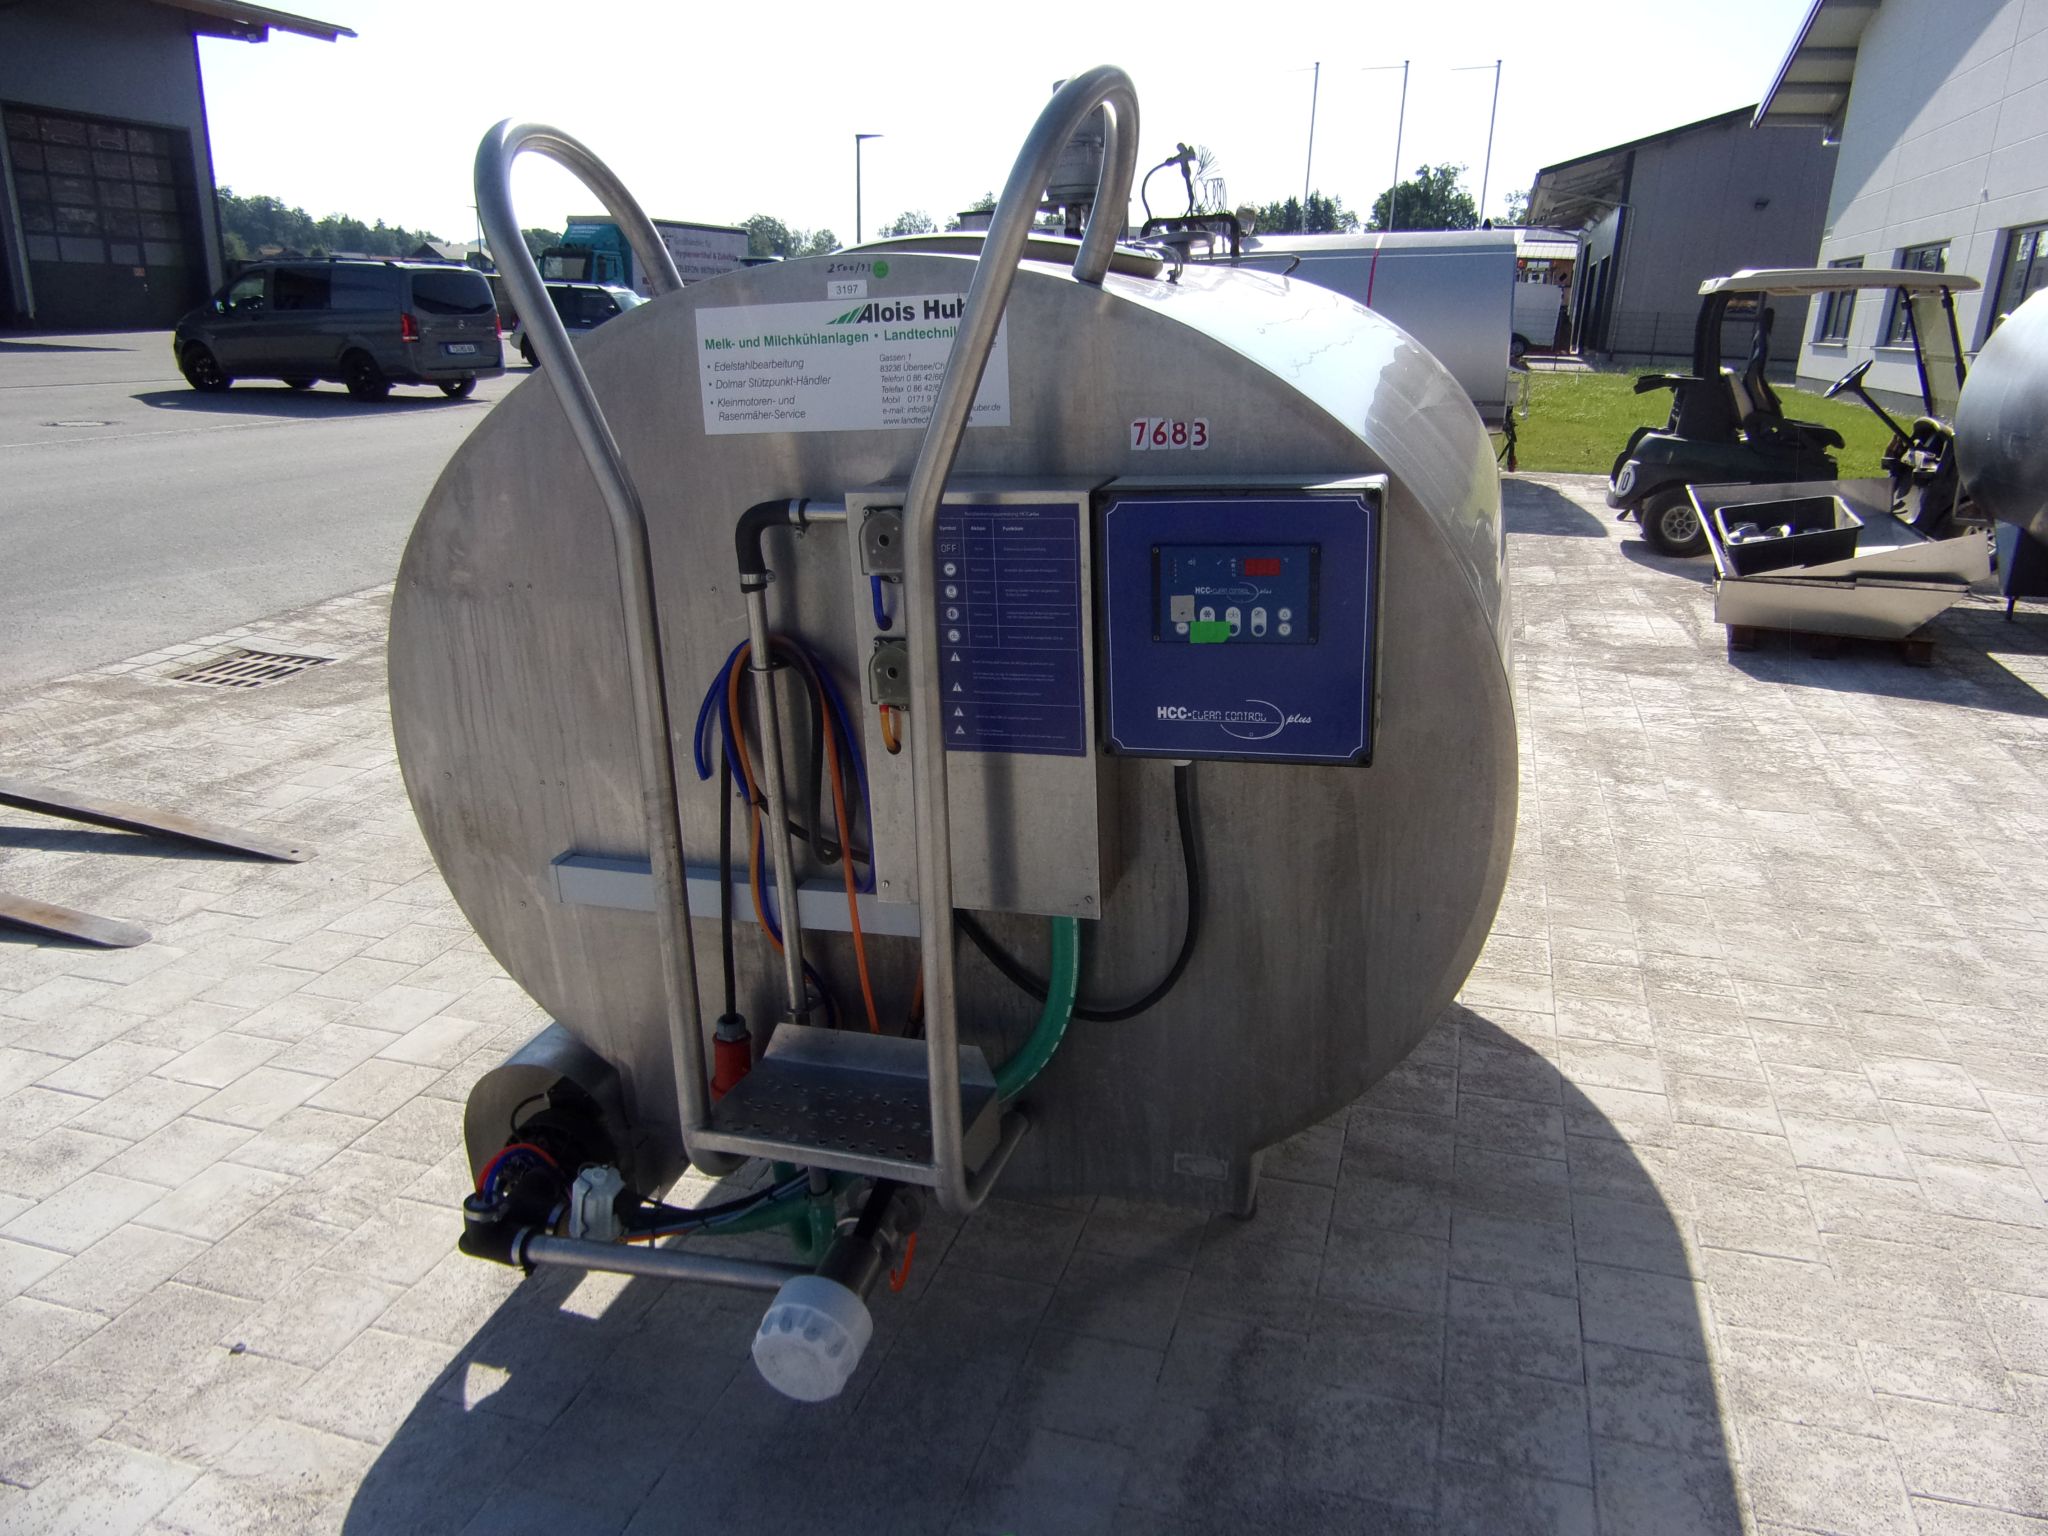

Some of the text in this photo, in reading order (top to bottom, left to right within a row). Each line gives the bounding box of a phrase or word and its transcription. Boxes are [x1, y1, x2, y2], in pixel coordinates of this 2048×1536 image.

[836, 284, 858, 295] 3197
[856, 301, 915, 324] Alois
[705, 326, 957, 350] Melk- und Milchkühlanlagen Landtechni
[714, 358, 804, 371] Edelstahlbearbeitung
[903, 361, 944, 372] Übersee/Ch
[715, 375, 831, 389] Dolmar Stützpunkt-Händler
[881, 375, 905, 383] Telefon
[881, 385, 904, 394] Telefax
[717, 395, 796, 408] Kleinmotoren- und
[718, 409, 806, 422] Rasenmäher-Service
[1133, 421, 1207, 446] 7683
[940, 543, 957, 553] OFF
[1225, 711, 1267, 722] CONTROL
[1285, 713, 1312, 725] plus
